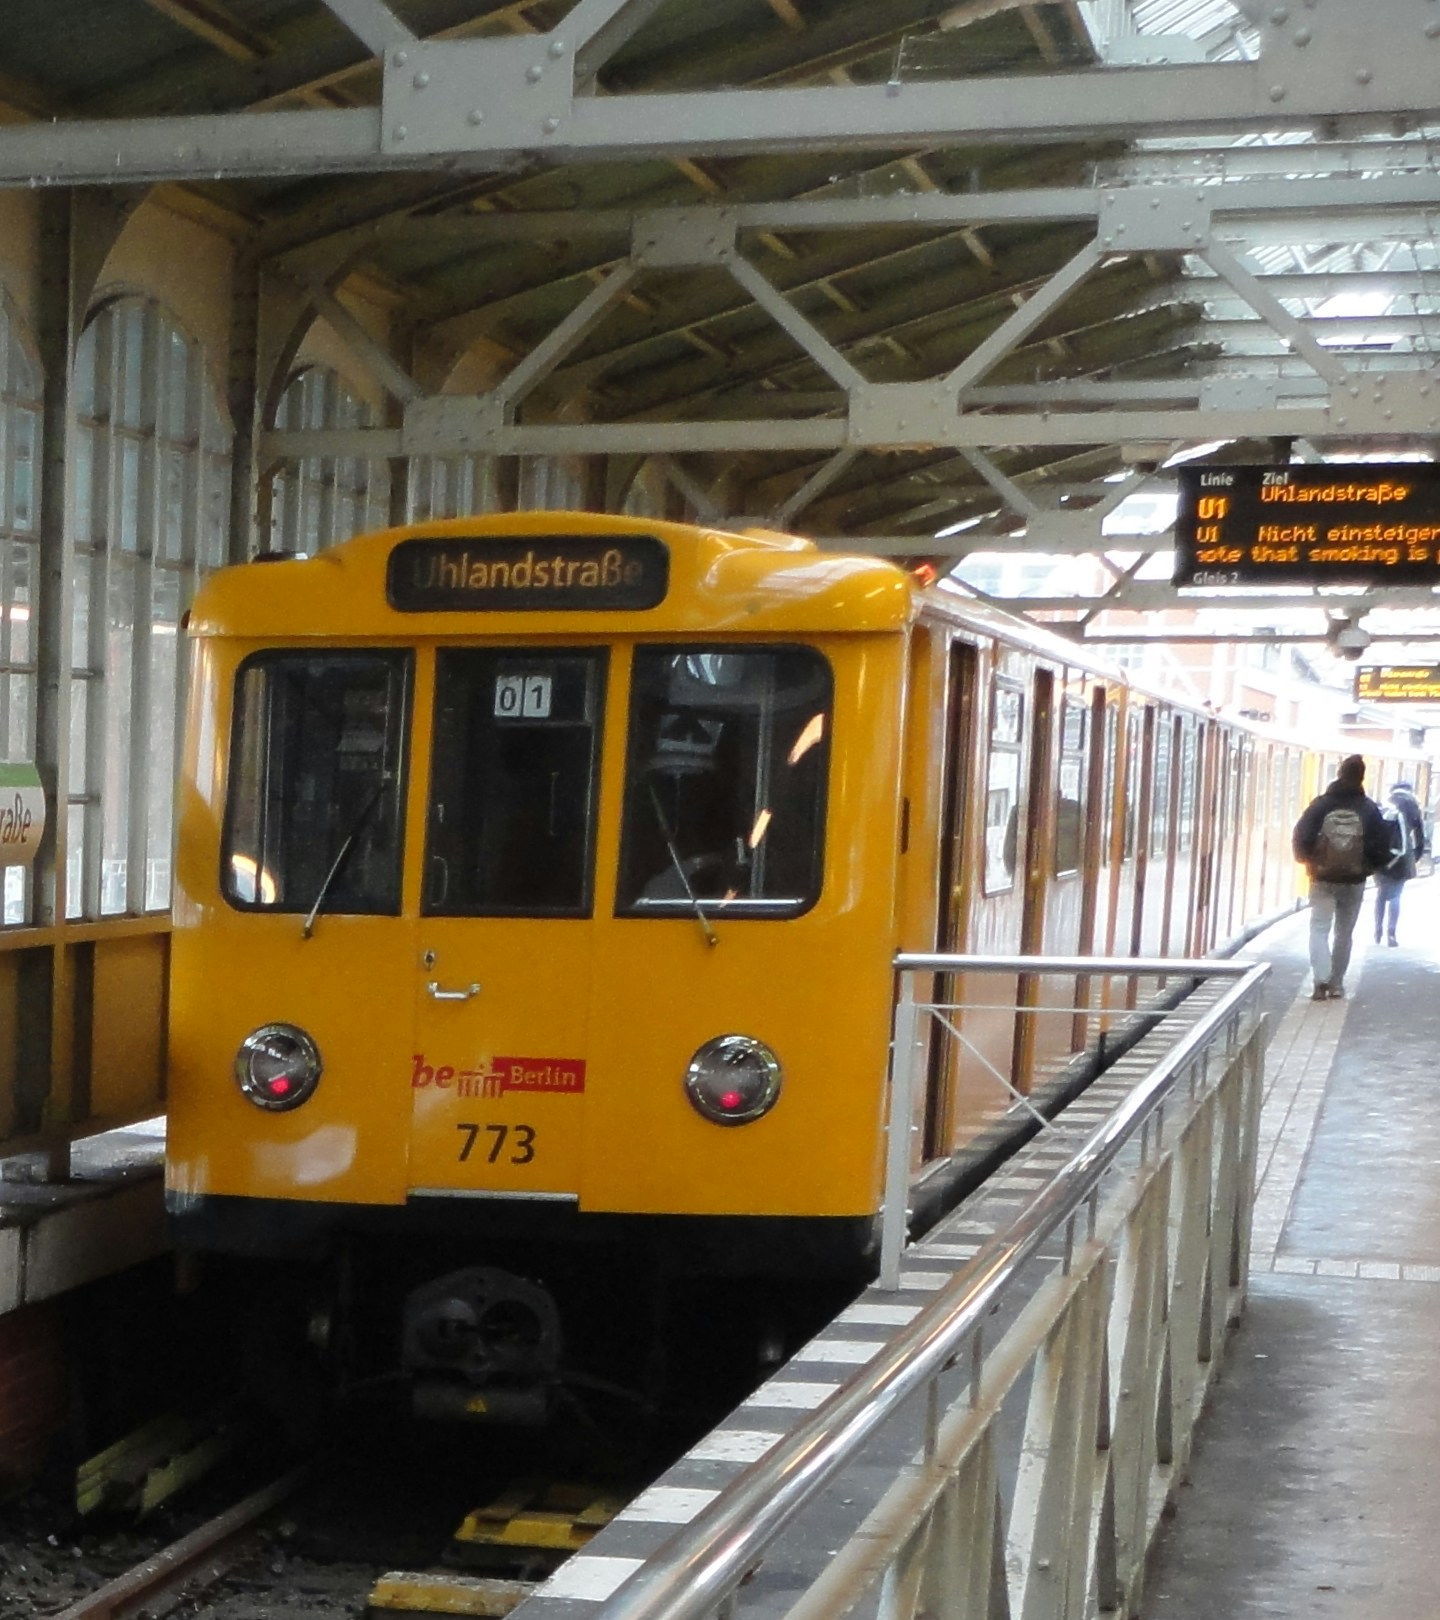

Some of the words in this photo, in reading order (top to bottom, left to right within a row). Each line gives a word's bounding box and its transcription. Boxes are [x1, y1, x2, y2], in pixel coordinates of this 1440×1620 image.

[1200, 472, 1234, 487] Linie
[1262, 471, 1289, 486] Ziel
[1261, 484, 1408, 505] Uhlandstraße
[1198, 498, 1227, 519] U1
[1196, 525, 1219, 543] U1
[1258, 525, 1318, 542] Nicht
[1251, 545, 1300, 563] that
[1308, 545, 1400, 565] smoking
[1407, 545, 1429, 562] is
[1231, 571, 1239, 585] 2
[498, 684, 544, 712] 01
[411, 1054, 455, 1089] be
[509, 1065, 577, 1087] Berlin
[456, 1123, 537, 1165] 773
